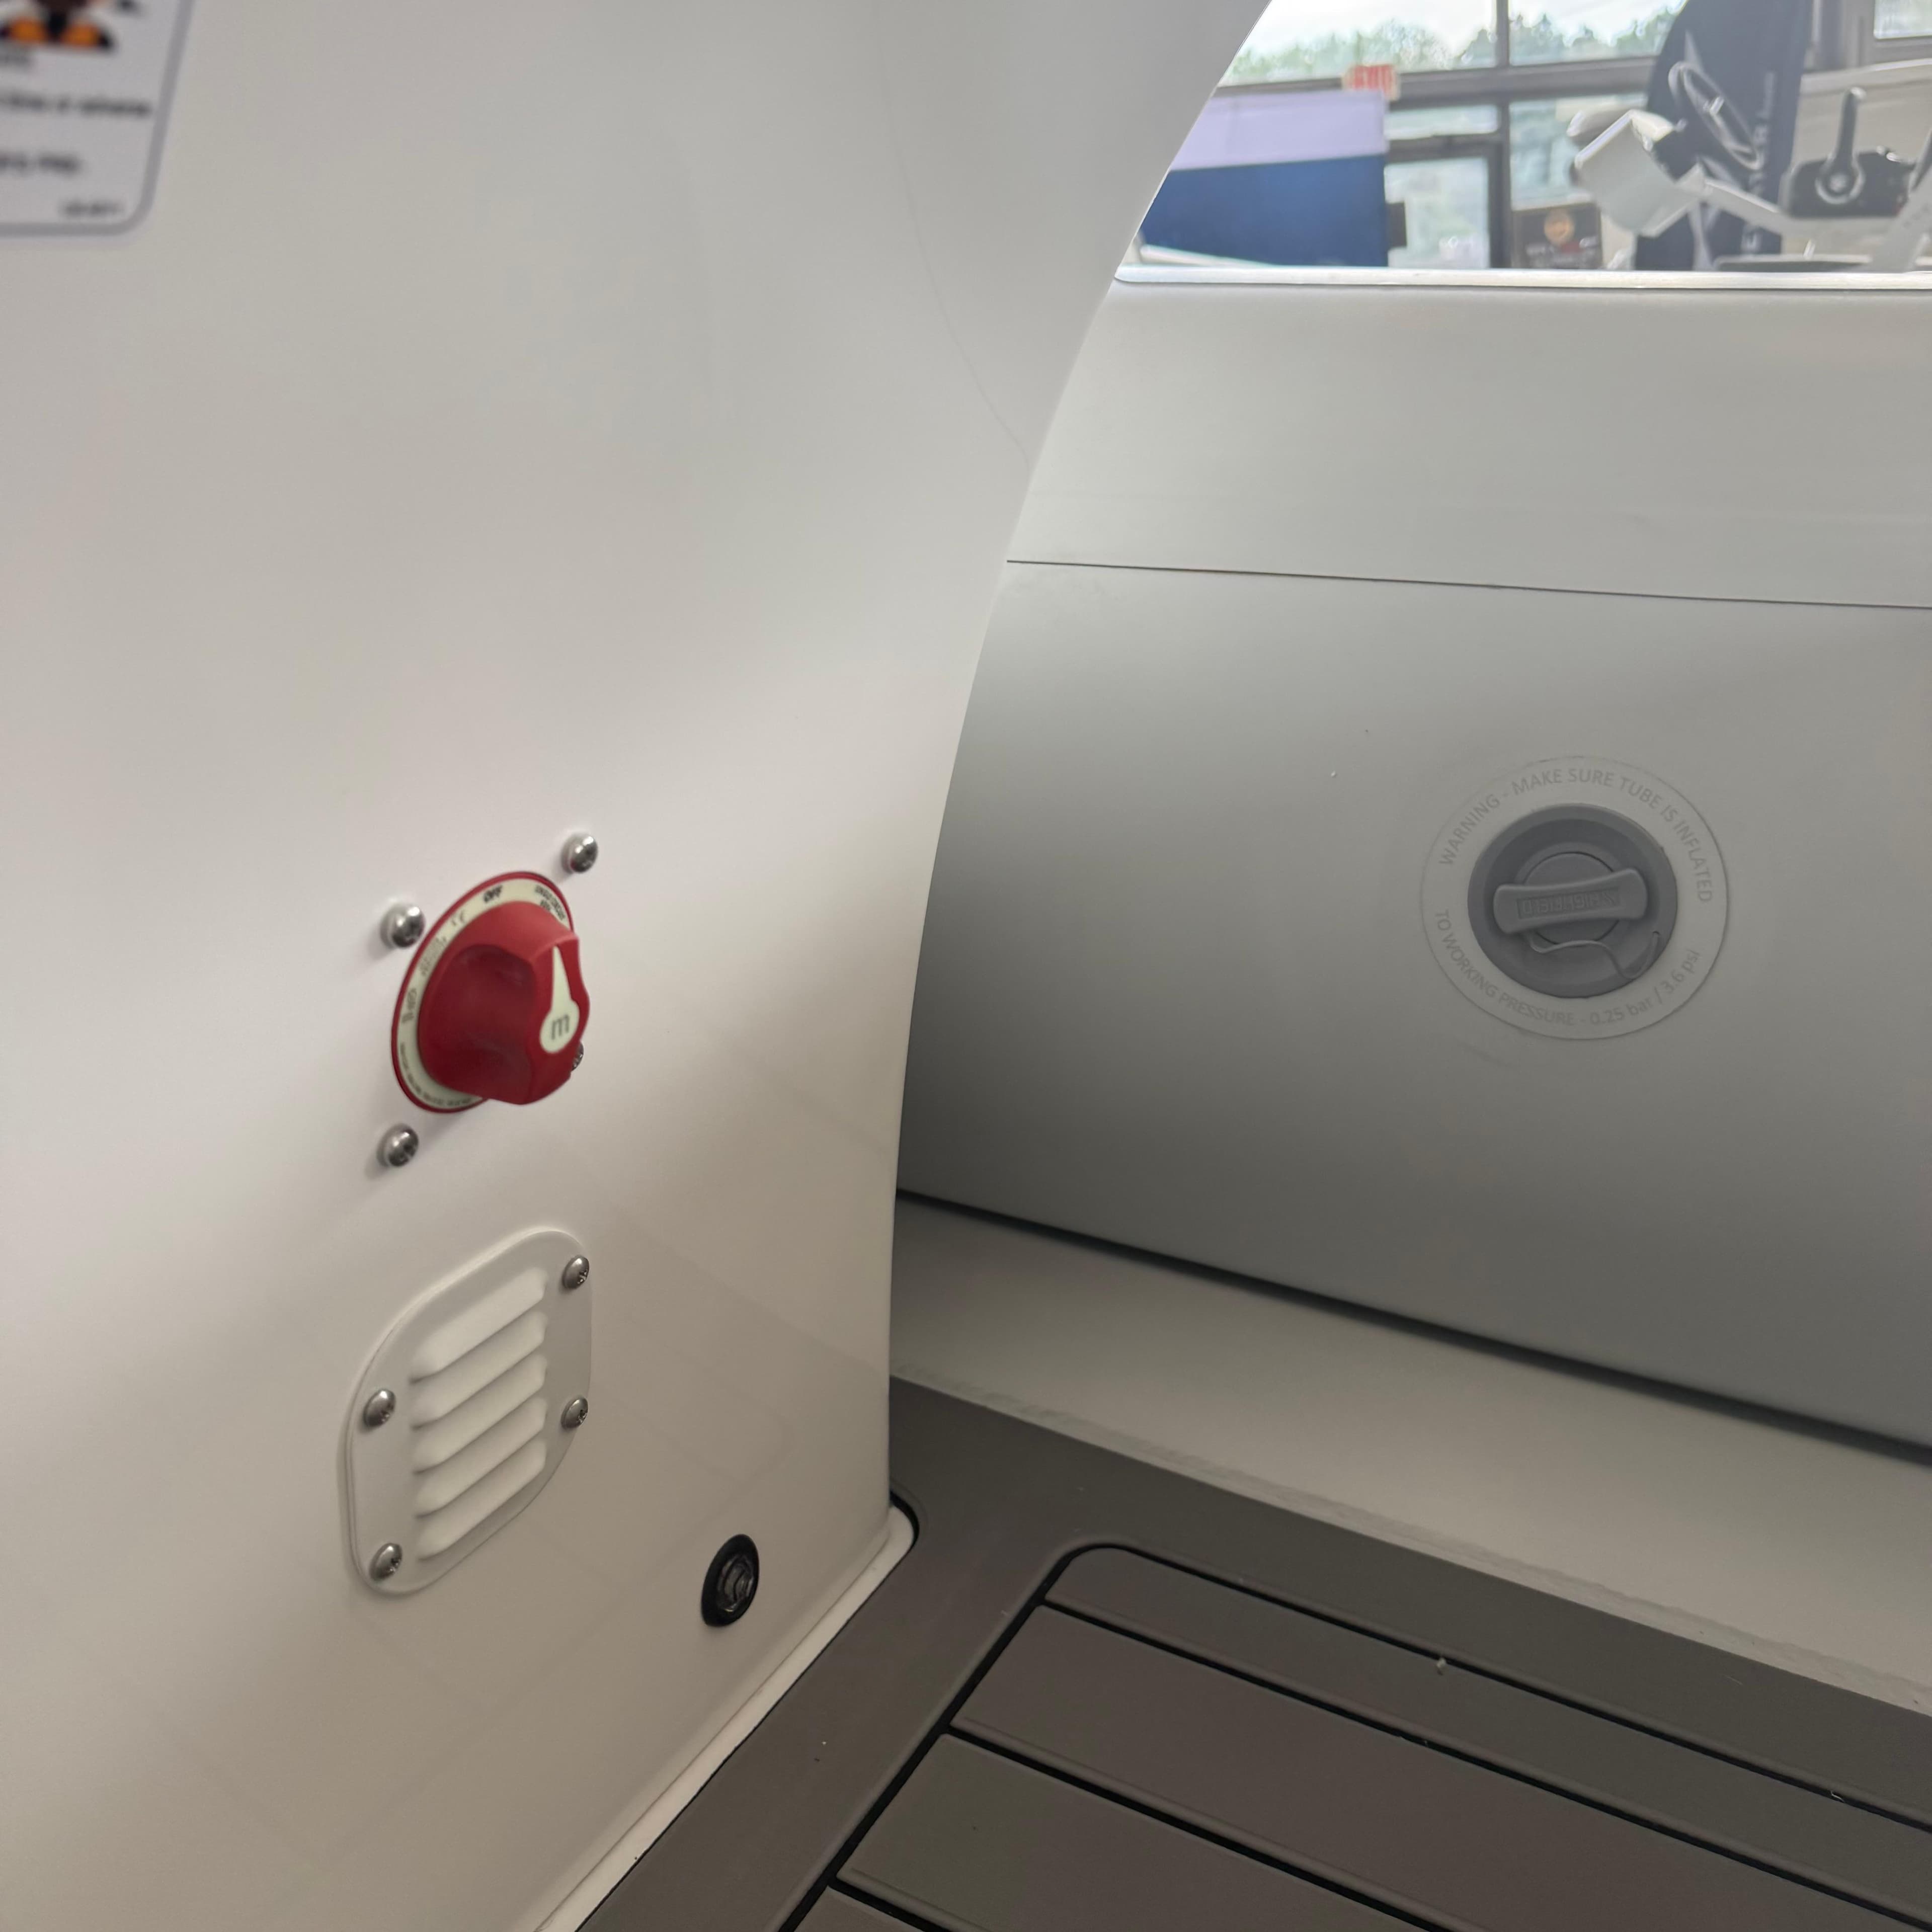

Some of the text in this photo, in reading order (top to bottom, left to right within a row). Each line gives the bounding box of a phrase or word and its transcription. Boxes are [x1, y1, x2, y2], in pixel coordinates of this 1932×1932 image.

[1438, 793, 1501, 865] WARNING
[1511, 768, 1563, 795] MAKE
[1567, 768, 1615, 787] SURE
[1620, 776, 1662, 809] TUBE
[1660, 804, 1678, 822] IS
[1673, 820, 1712, 902] INFLATED
[1435, 908, 1452, 931] TO
[1442, 932, 1498, 997] WORKING
[1681, 948, 1701, 974] psi
[1660, 969, 1685, 994] 3.6
[1626, 997, 1653, 1016] bar
[1654, 986, 1662, 1004] /
[1498, 992, 1575, 1026] PRESSURE
[1589, 1007, 1625, 1024] 0.25
